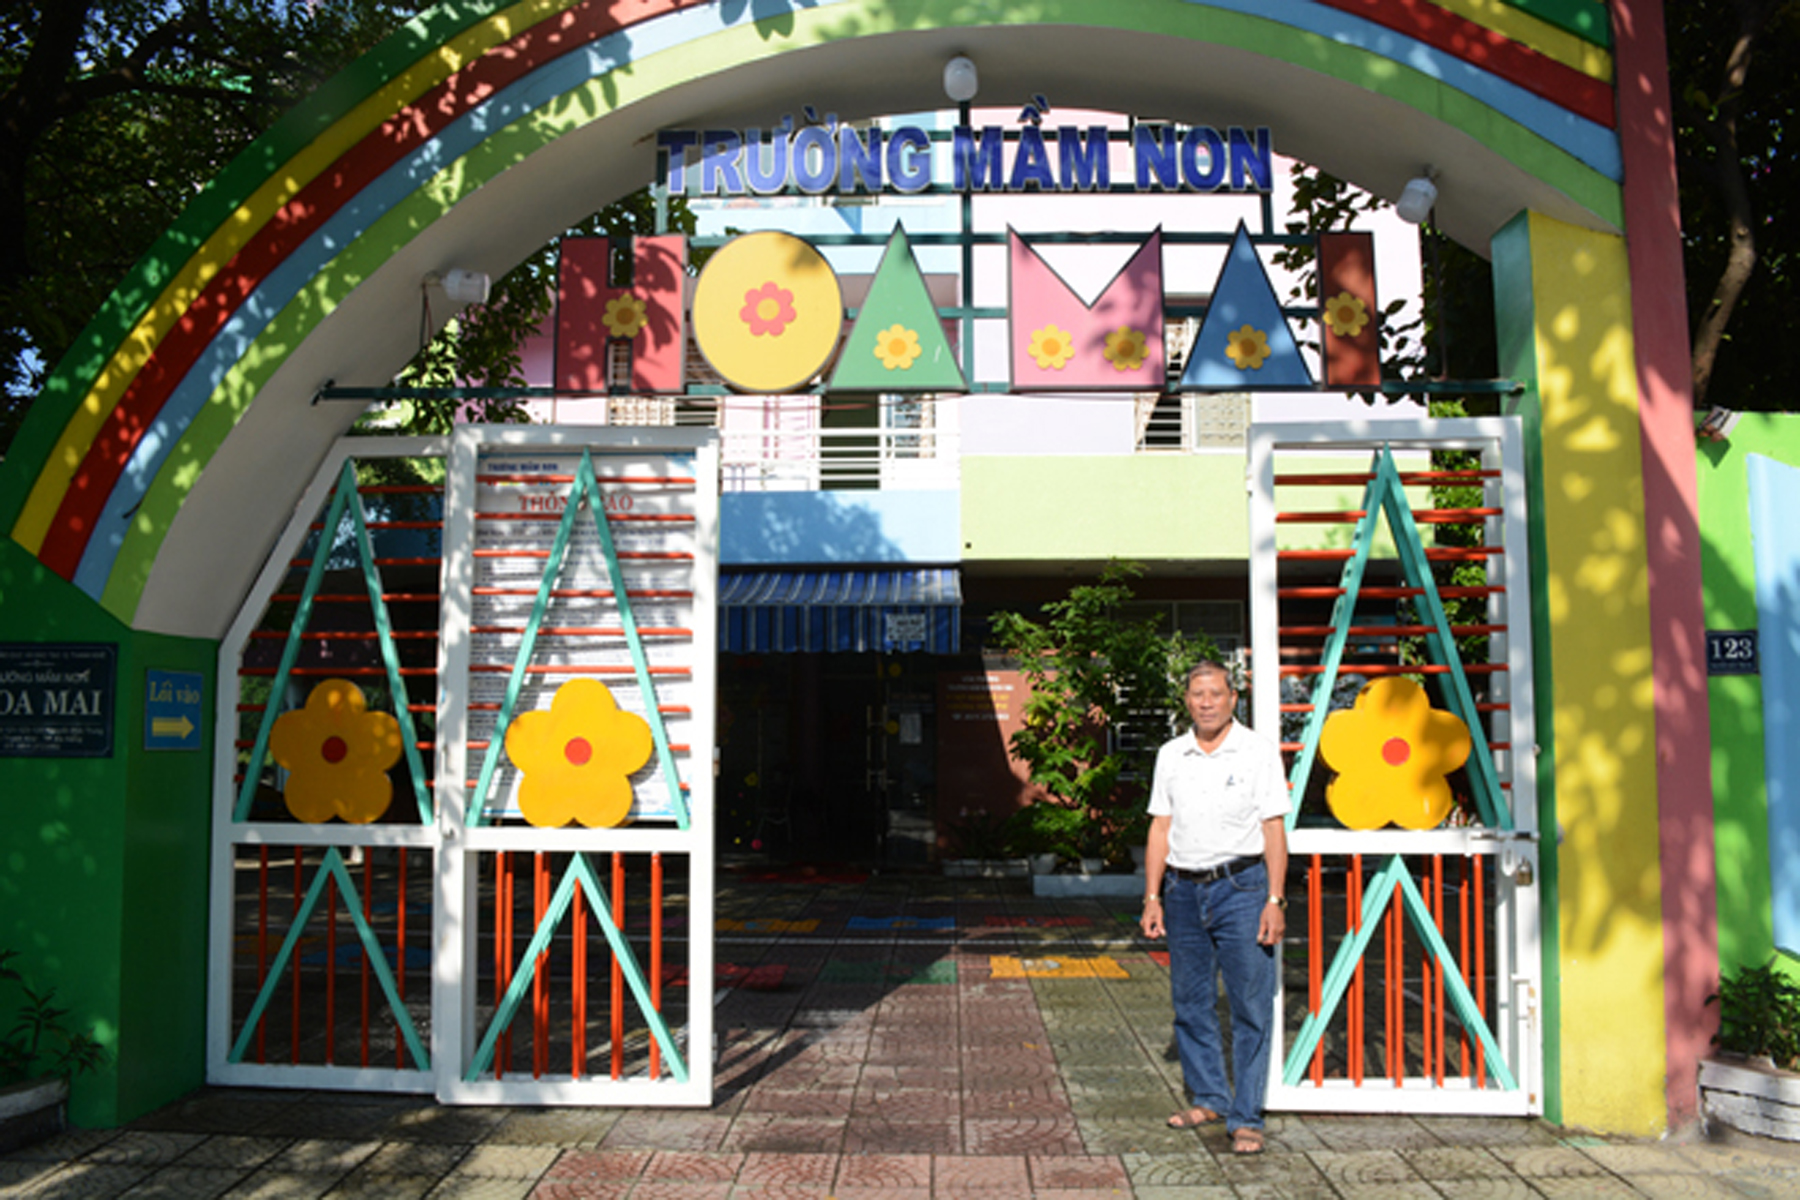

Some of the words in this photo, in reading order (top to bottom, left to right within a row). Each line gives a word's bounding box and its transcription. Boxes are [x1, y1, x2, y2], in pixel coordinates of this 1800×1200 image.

[656, 106, 932, 194] TRƯỜNG
[951, 95, 1111, 192] MẦM
[1134, 125, 1273, 192] NON
[554, 218, 969, 394] HOA
[1006, 217, 1381, 391] MAI
[1711, 638, 1753, 659] 123
[43, 690, 102, 715] MAI
[150, 679, 173, 703] Lối
[176, 684, 200, 704] vào
